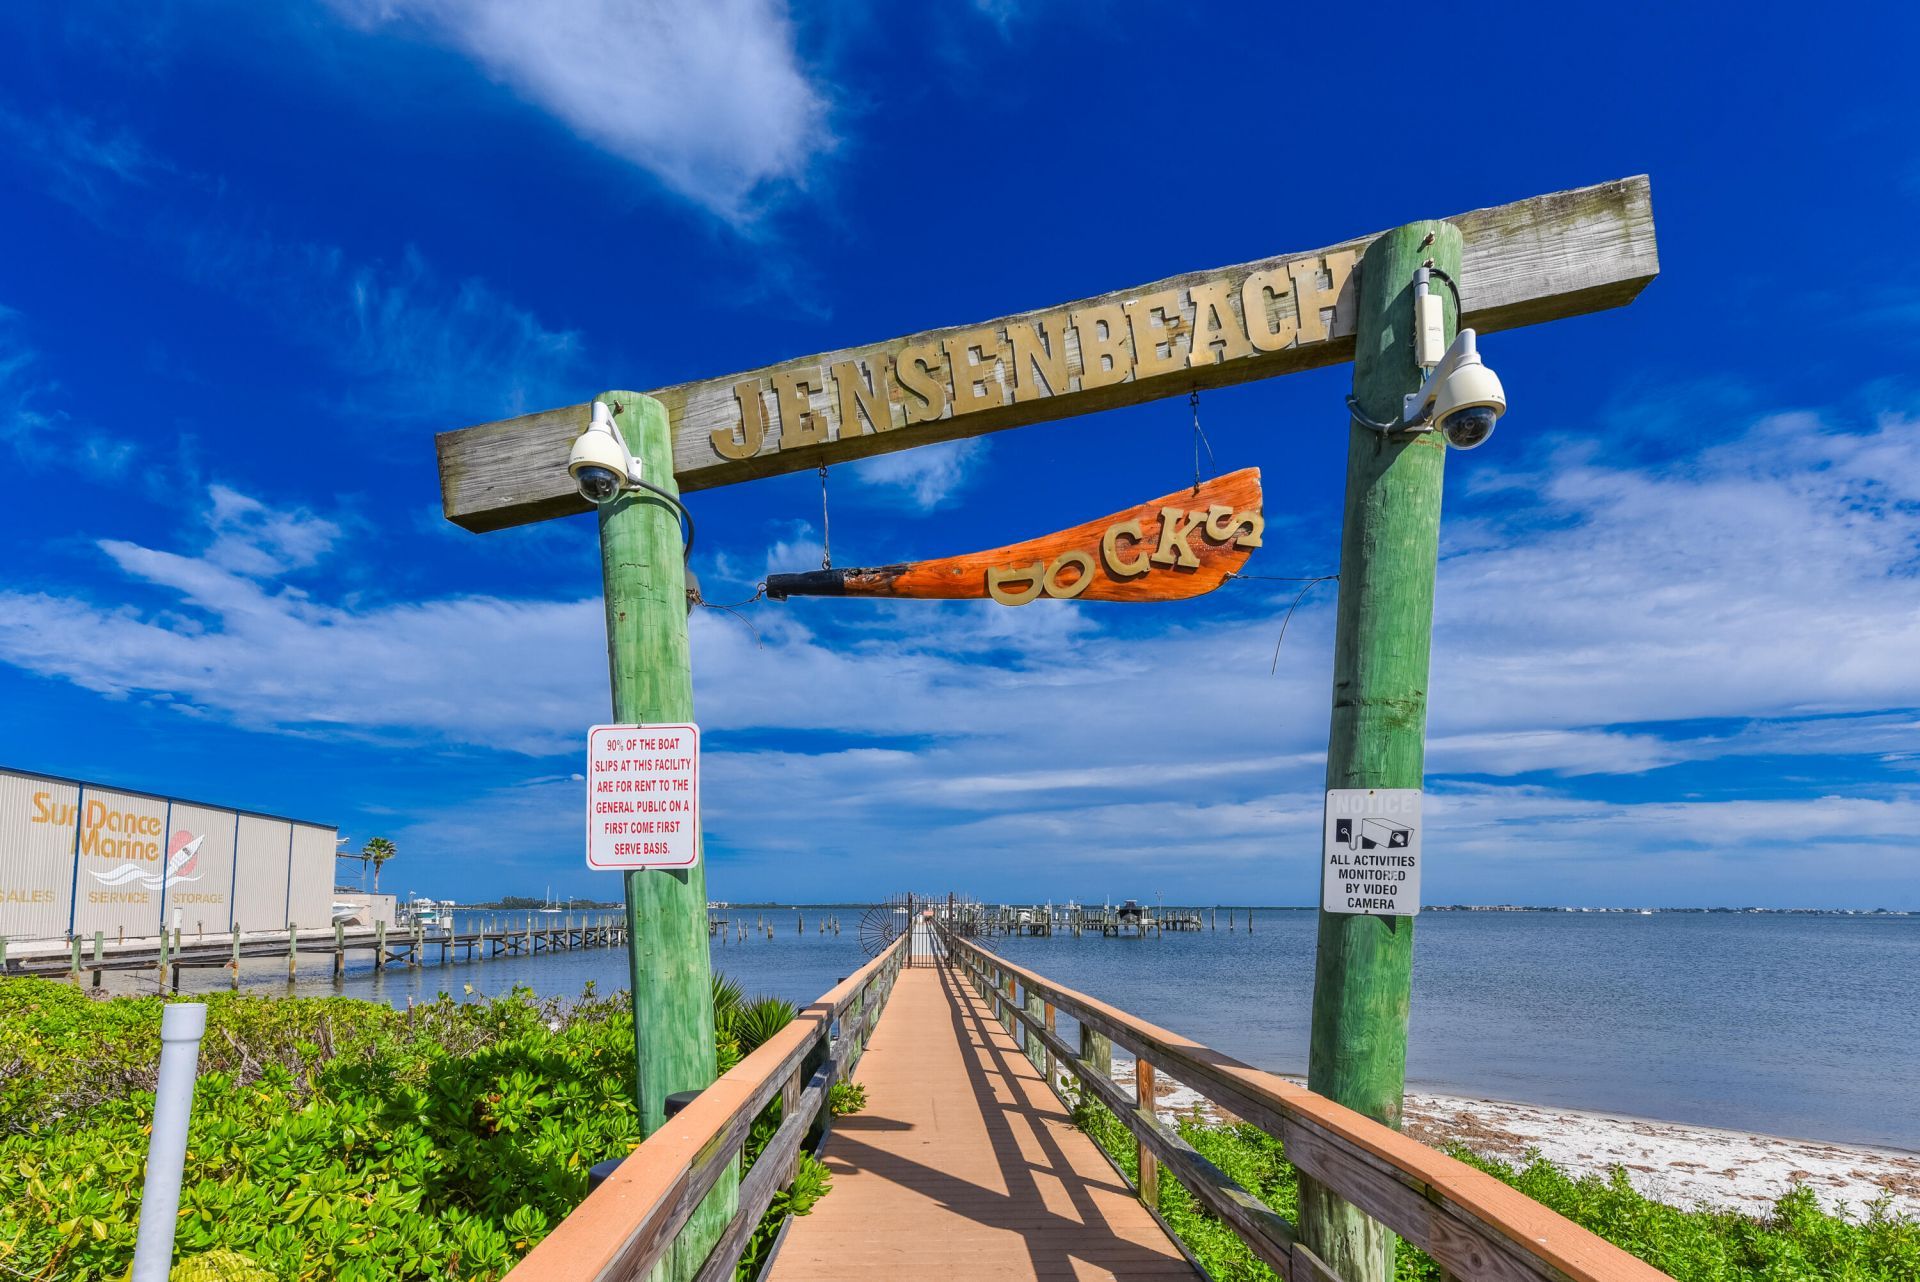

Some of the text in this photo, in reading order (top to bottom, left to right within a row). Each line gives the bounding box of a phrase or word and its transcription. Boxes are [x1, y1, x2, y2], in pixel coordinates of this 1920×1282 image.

[987, 504, 1265, 606] DOCKS
[607, 738, 680, 751] 90% OF THE BOAT
[595, 758, 691, 772] SLIPS AT THIS FACILITY
[597, 779, 688, 792] ARE FOR RENT TO THE
[596, 800, 689, 813] GENERAL PUBLIC ON A
[1336, 794, 1413, 813] NOTICE
[604, 821, 681, 834] FIRST COME FIRST
[71, 824, 160, 861] Marine
[614, 842, 670, 855] SERVE BASIS.
[1330, 854, 1415, 867] ALL ACTIVITIES
[1338, 869, 1406, 881] MONITORED
[1345, 883, 1397, 896] BY VIDEO
[88, 891, 149, 904] SERVICE
[173, 893, 224, 904] STORAGE
[1347, 897, 1395, 909] CAMERA
